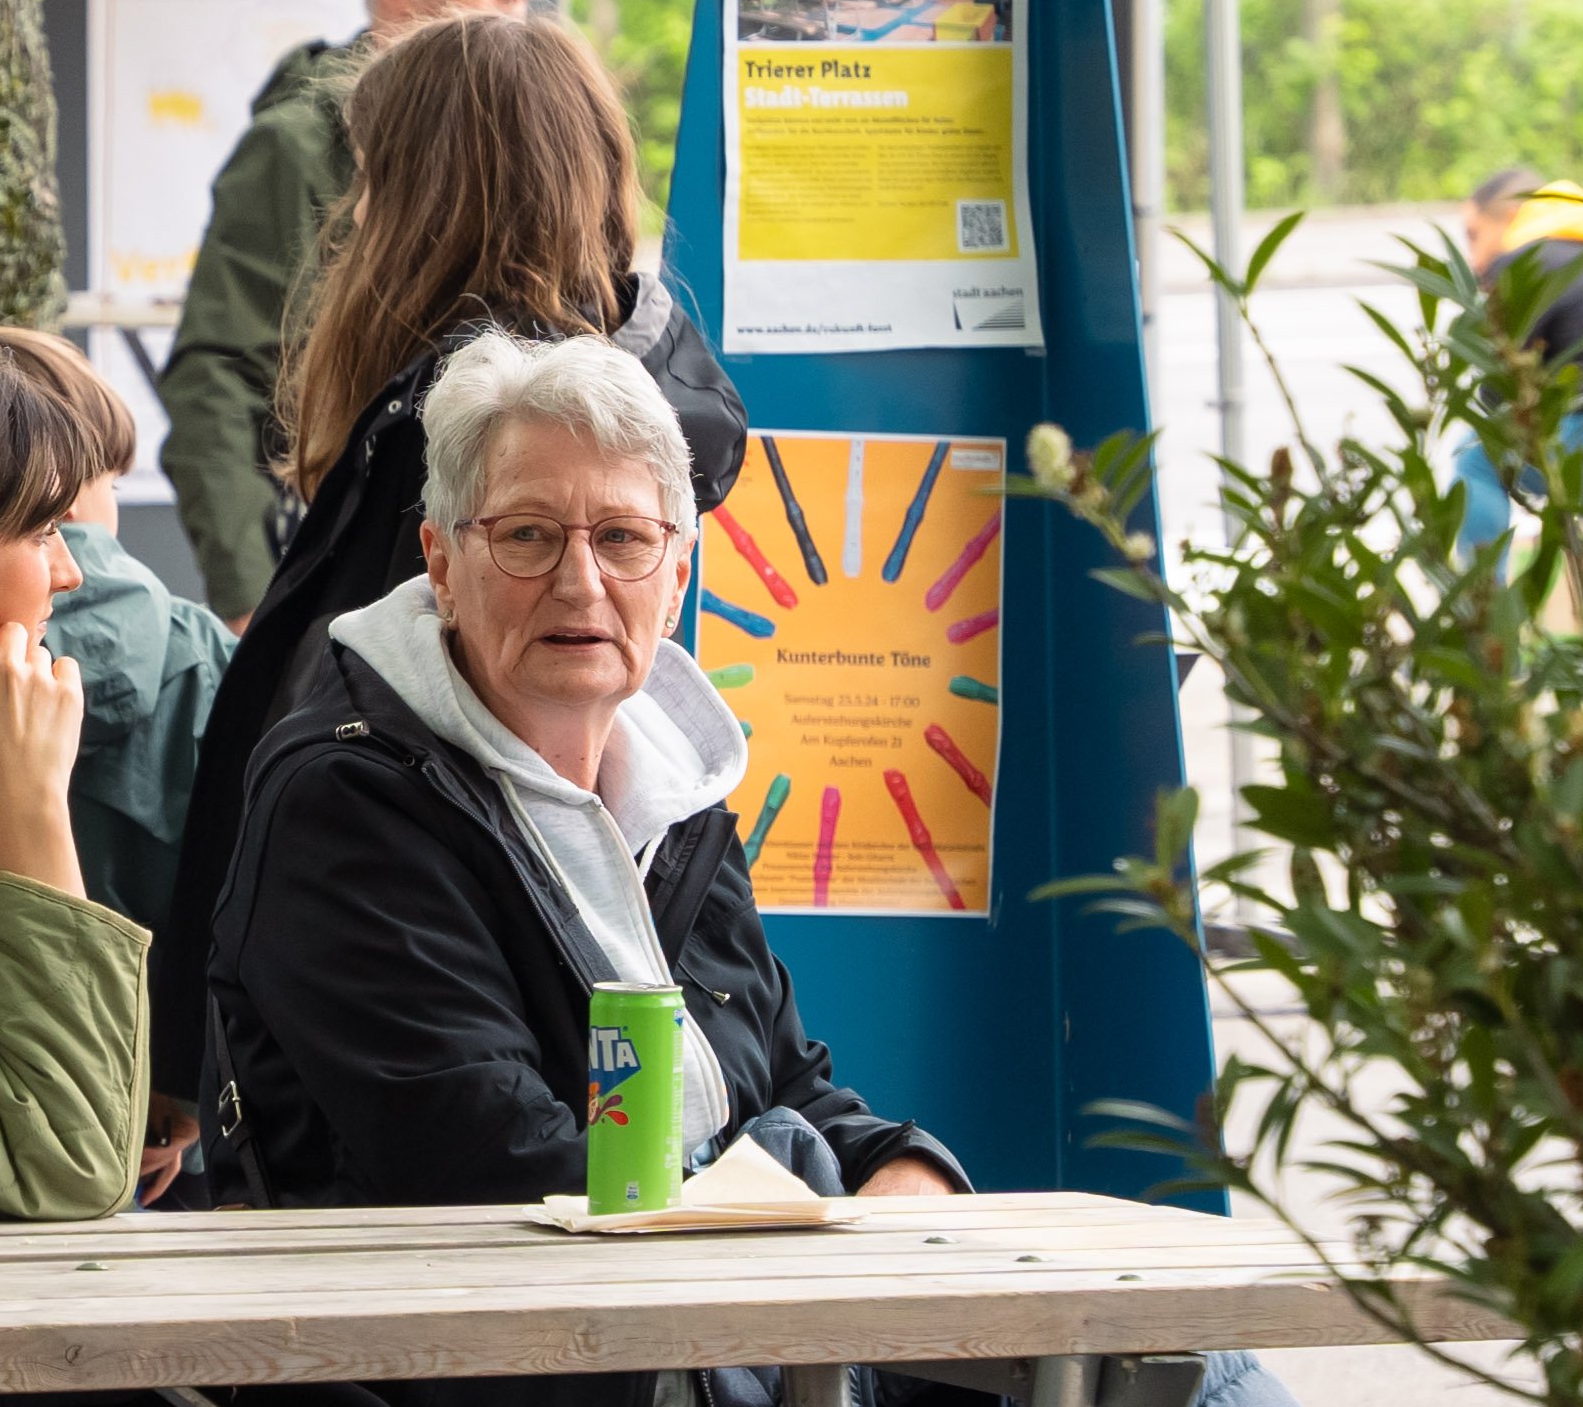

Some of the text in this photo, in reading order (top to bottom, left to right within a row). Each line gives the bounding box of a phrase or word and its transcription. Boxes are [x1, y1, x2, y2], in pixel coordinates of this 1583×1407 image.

[745, 59, 872, 80] Trierer Platz
[744, 83, 909, 110] Stadt-Terrassen
[777, 649, 932, 669] Kunterbunte Töne
[829, 754, 873, 768] Aachen
